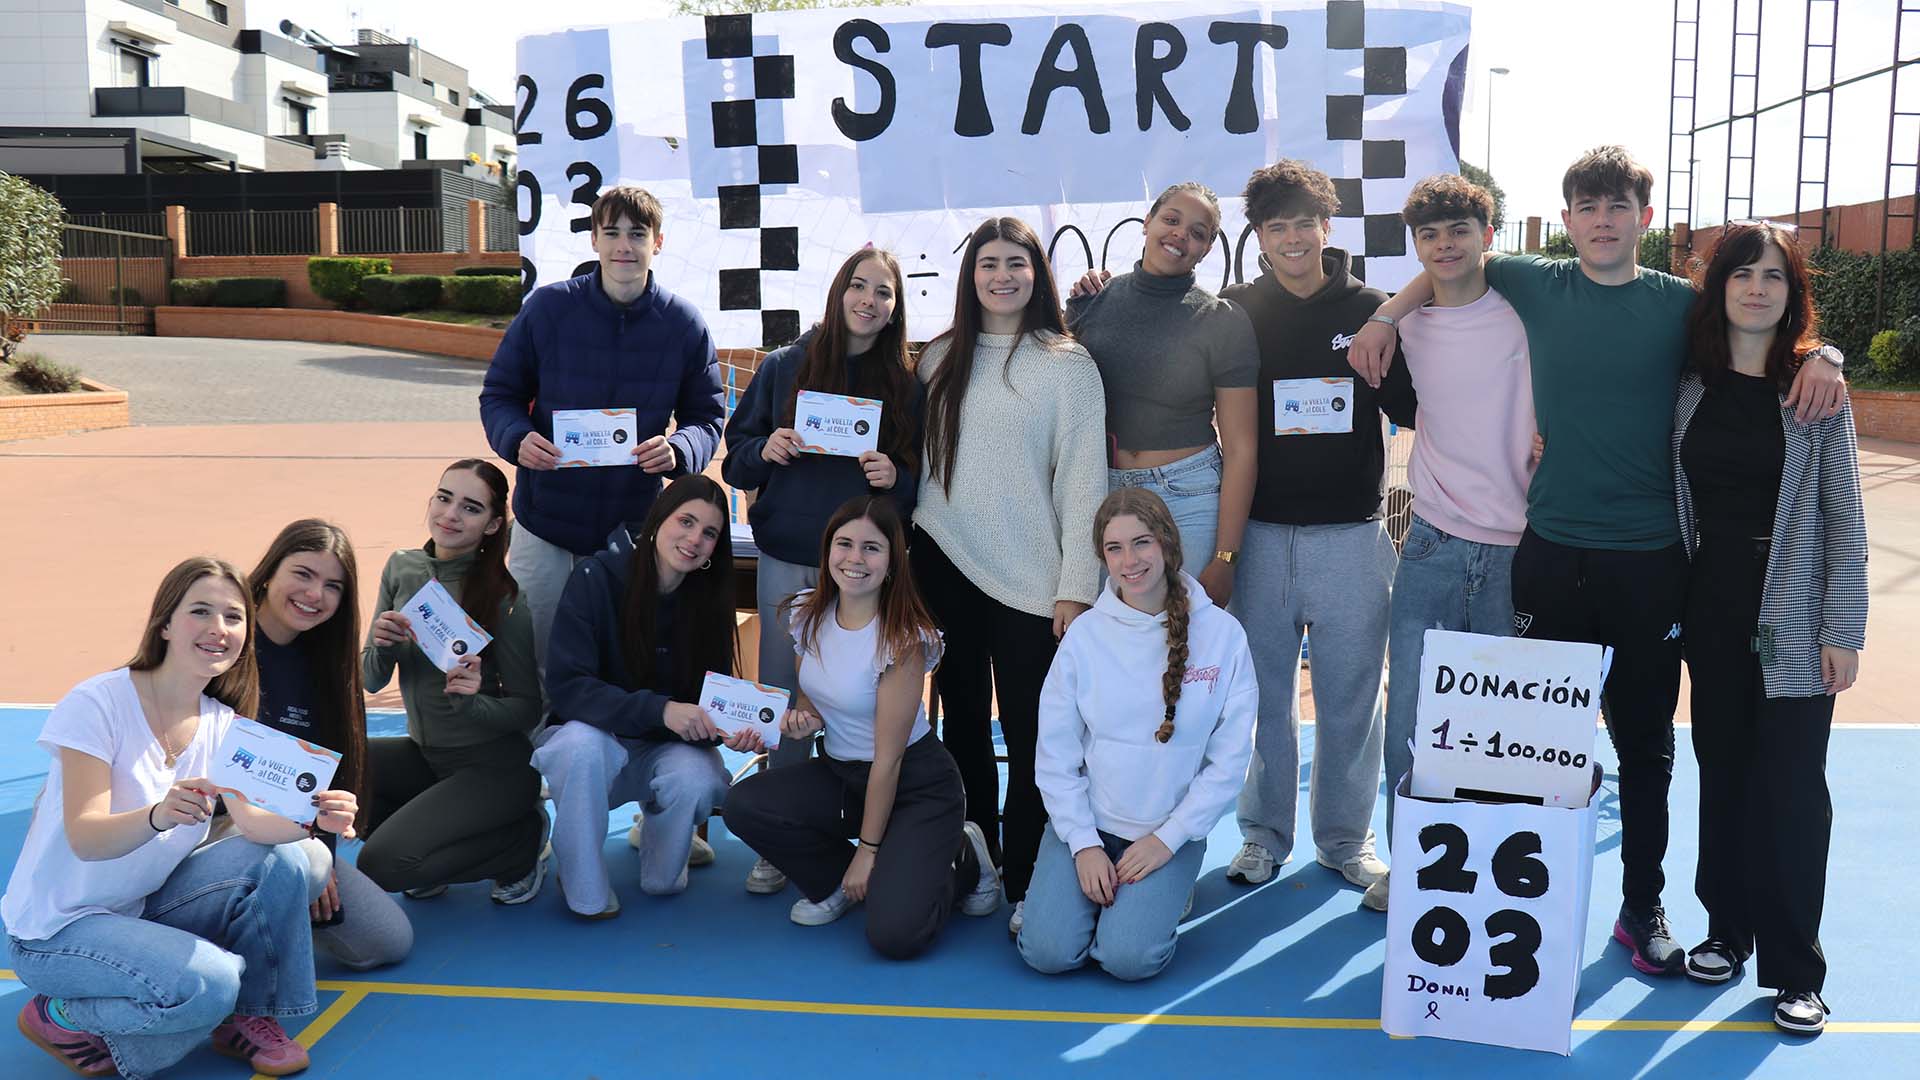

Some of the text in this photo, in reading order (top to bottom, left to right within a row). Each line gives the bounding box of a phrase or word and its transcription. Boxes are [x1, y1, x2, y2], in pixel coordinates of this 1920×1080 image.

[831, 18, 1288, 142] START
[266, 771, 288, 786] COLE
[268, 760, 297, 777] VUELTA
[1416, 822, 1550, 898] 26
